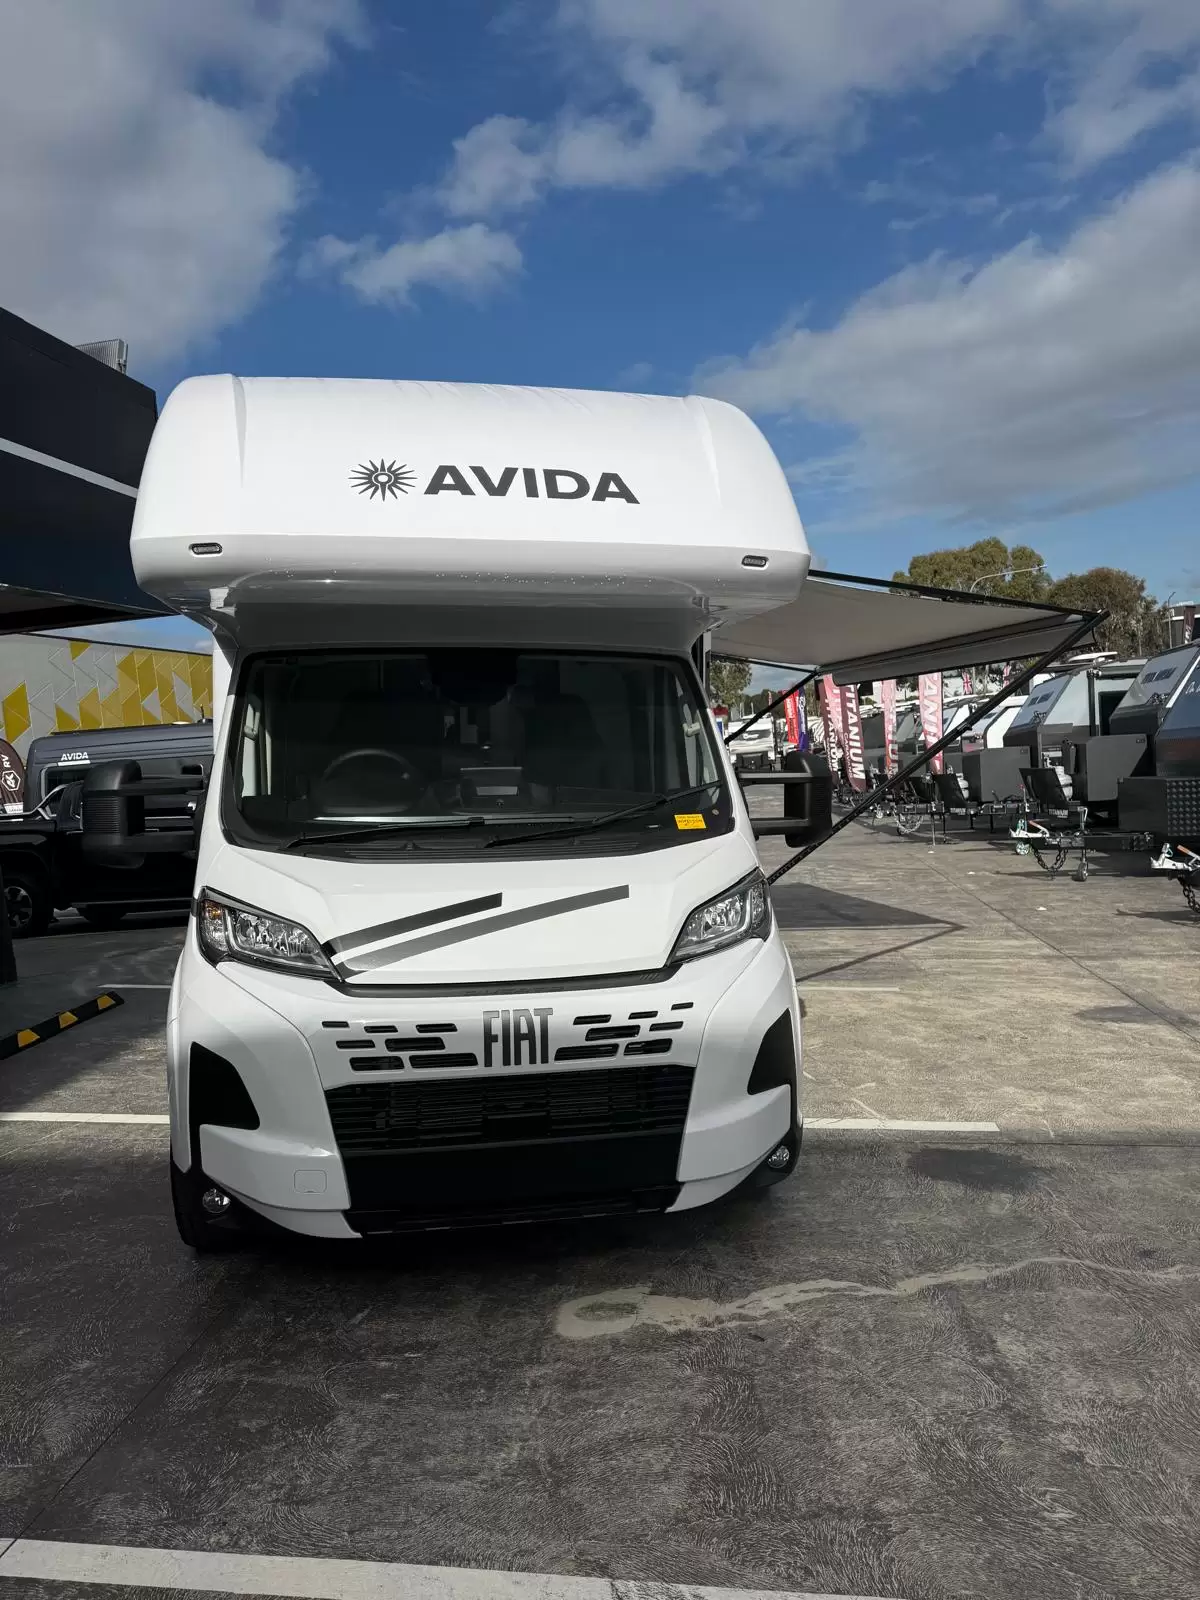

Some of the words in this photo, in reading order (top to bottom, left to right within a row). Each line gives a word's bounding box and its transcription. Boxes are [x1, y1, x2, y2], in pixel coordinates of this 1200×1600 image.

[423, 464, 641, 505] AVIDA
[60, 752, 89, 761] AVIDA
[483, 1007, 554, 1067] FIAT
